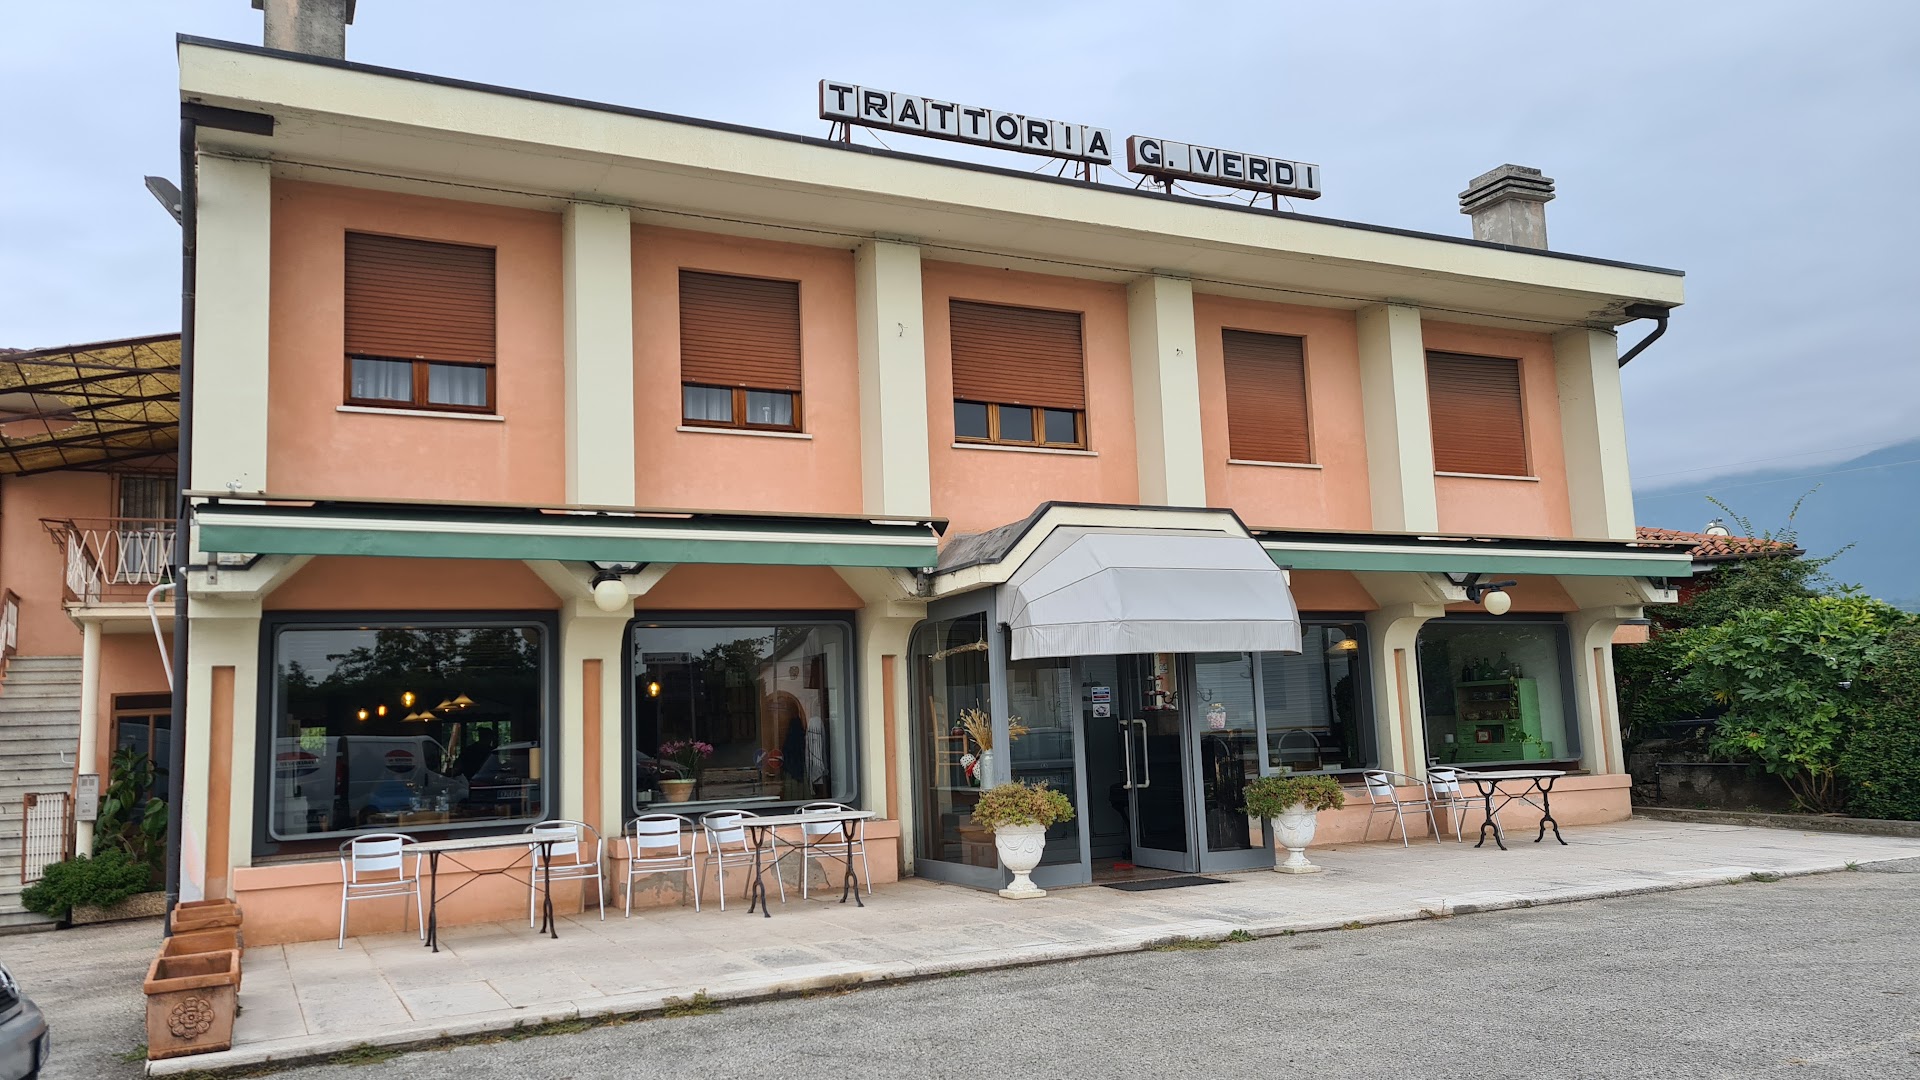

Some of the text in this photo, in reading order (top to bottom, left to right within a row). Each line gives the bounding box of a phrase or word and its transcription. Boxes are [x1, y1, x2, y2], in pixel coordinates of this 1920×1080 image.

[828, 84, 1314, 189] TRATTORIA G. VERDI
